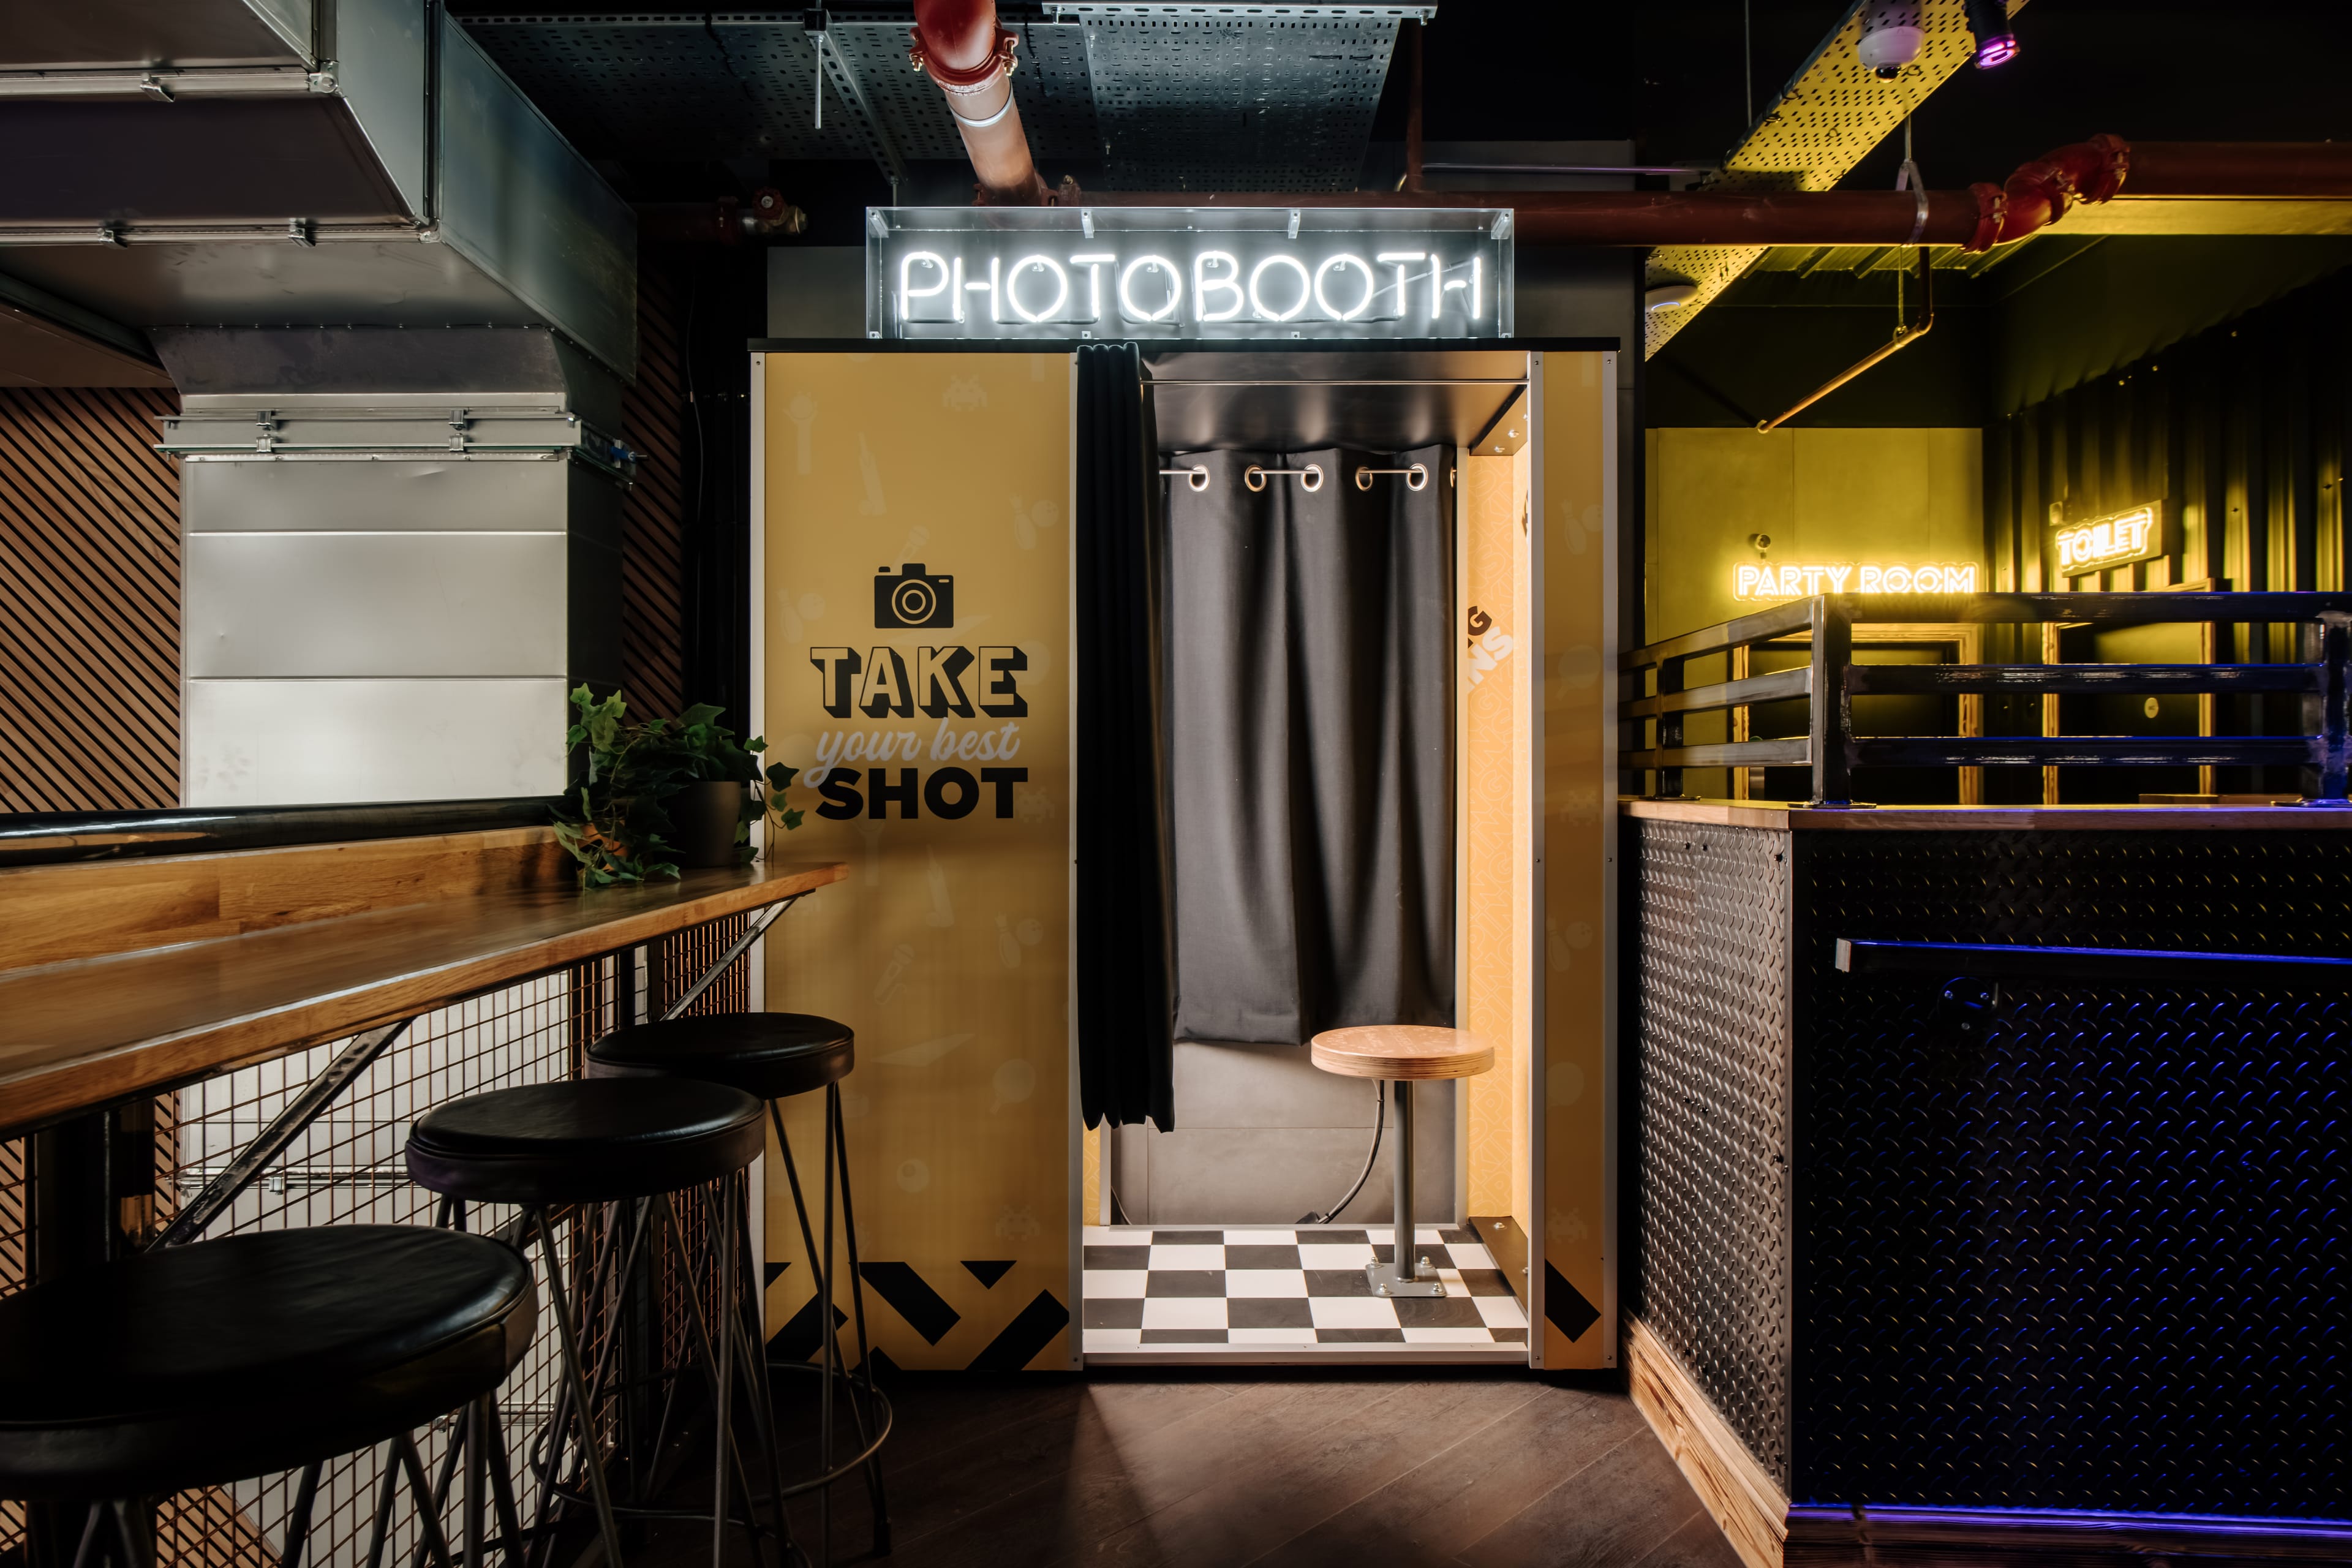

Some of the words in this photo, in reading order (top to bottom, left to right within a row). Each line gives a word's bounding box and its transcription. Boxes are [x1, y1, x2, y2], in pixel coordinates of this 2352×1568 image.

[899, 250, 1483, 323] PHOTOBOOTH
[2057, 513, 2149, 566] TOILET
[1738, 565, 1853, 596] PARTY
[1860, 566, 1975, 594] ROOM
[810, 646, 1028, 718] TAKE
[803, 731, 921, 789] your
[929, 716, 1020, 761] best
[815, 767, 1028, 821] SHOT
